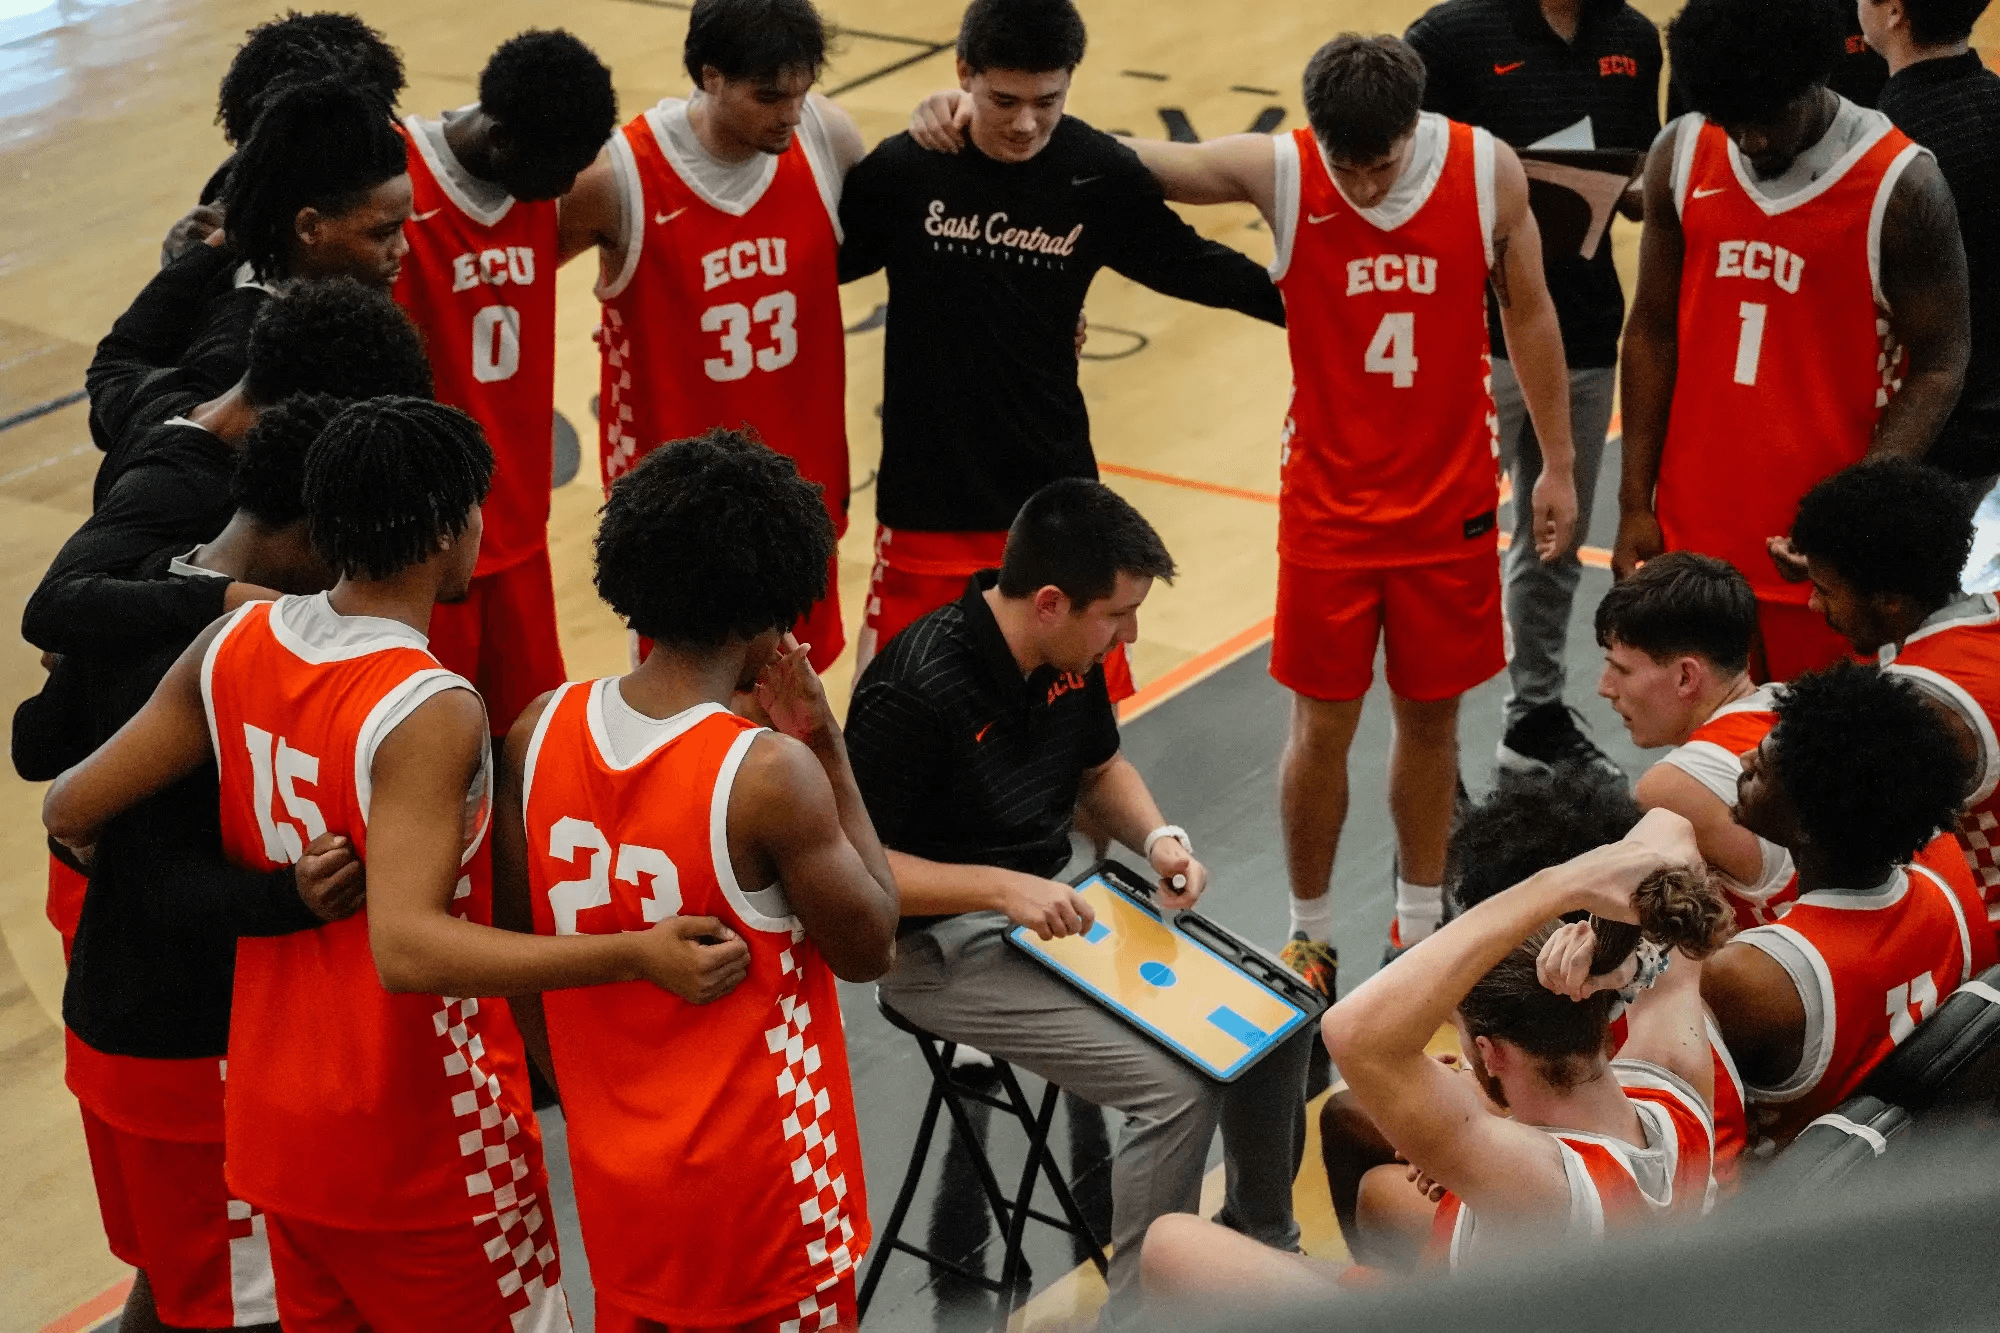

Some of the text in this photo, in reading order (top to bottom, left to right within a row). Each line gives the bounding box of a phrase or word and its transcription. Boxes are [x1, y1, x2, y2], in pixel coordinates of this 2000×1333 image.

[1599, 55, 1637, 77] ECU
[924, 200, 1083, 256] East Central
[452, 246, 536, 293] ECU
[701, 237, 787, 292] ECU
[1346, 253, 1438, 297] ECU
[1715, 240, 1806, 295] ECU
[472, 305, 521, 384] 0
[700, 290, 799, 382] 33
[1364, 311, 1419, 389] 4
[1734, 301, 1767, 387] 1
[243, 722, 328, 864] 15
[548, 815, 684, 936] 23
